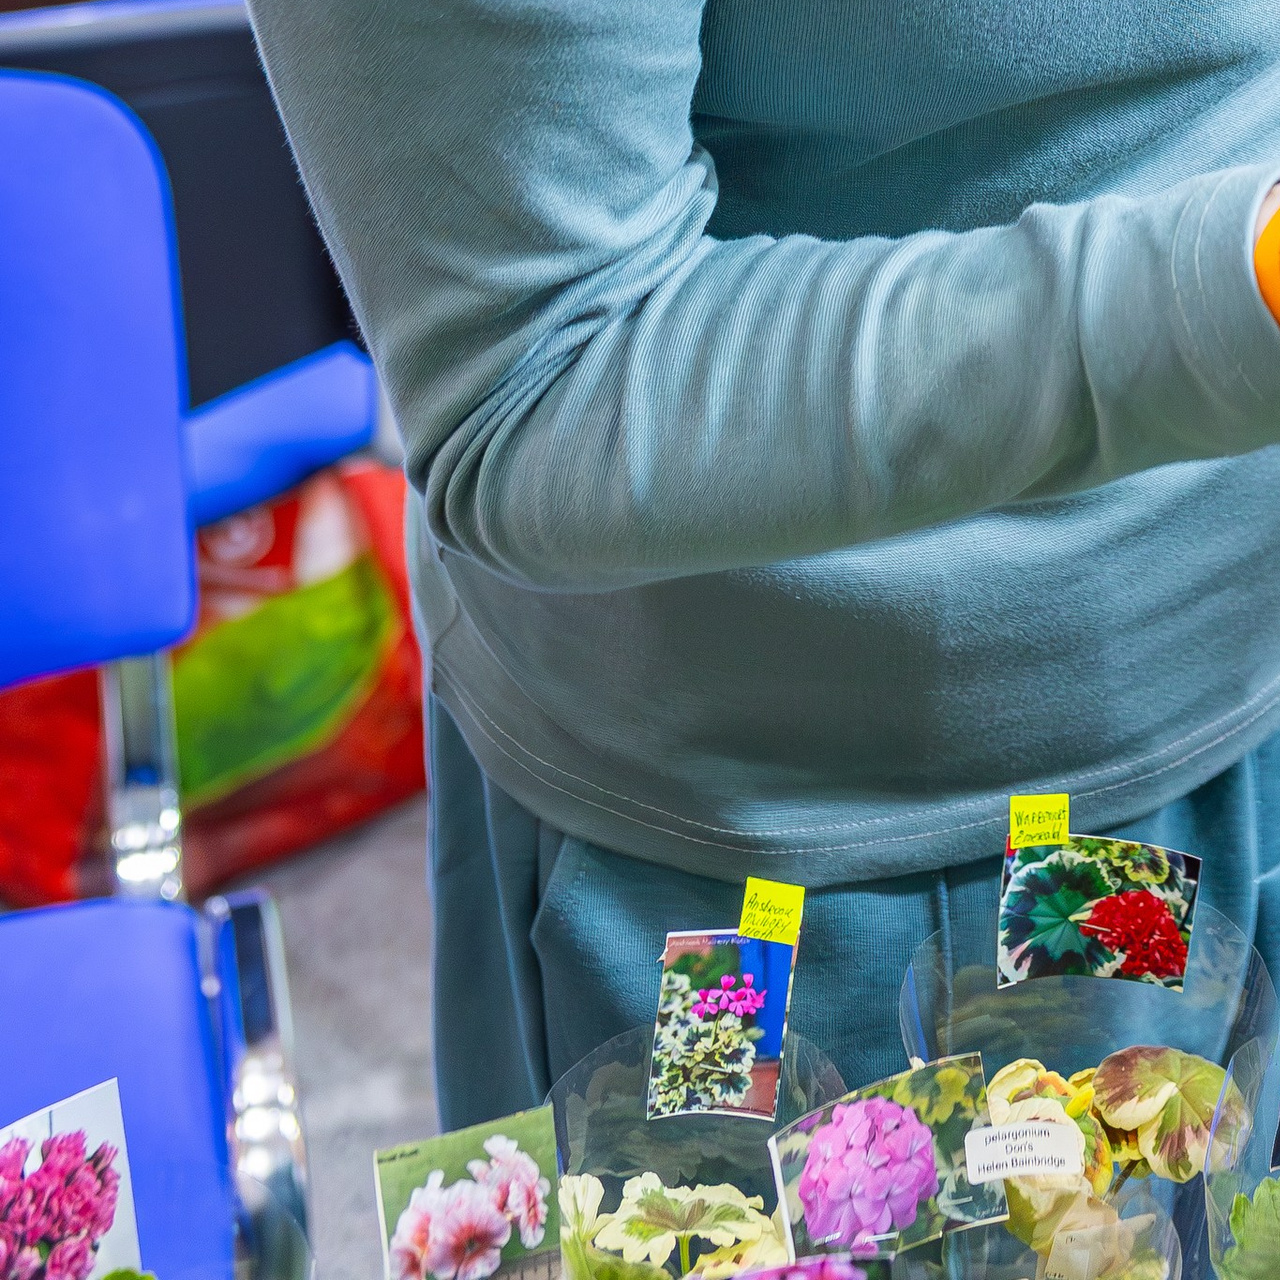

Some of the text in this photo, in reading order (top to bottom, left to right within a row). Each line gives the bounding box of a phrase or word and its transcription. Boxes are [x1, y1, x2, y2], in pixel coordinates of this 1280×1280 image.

[984, 1127, 1050, 1146] pelargonium
[1005, 1141, 1033, 1155] Don's
[978, 1155, 1065, 1175] Helen Bainbridge
